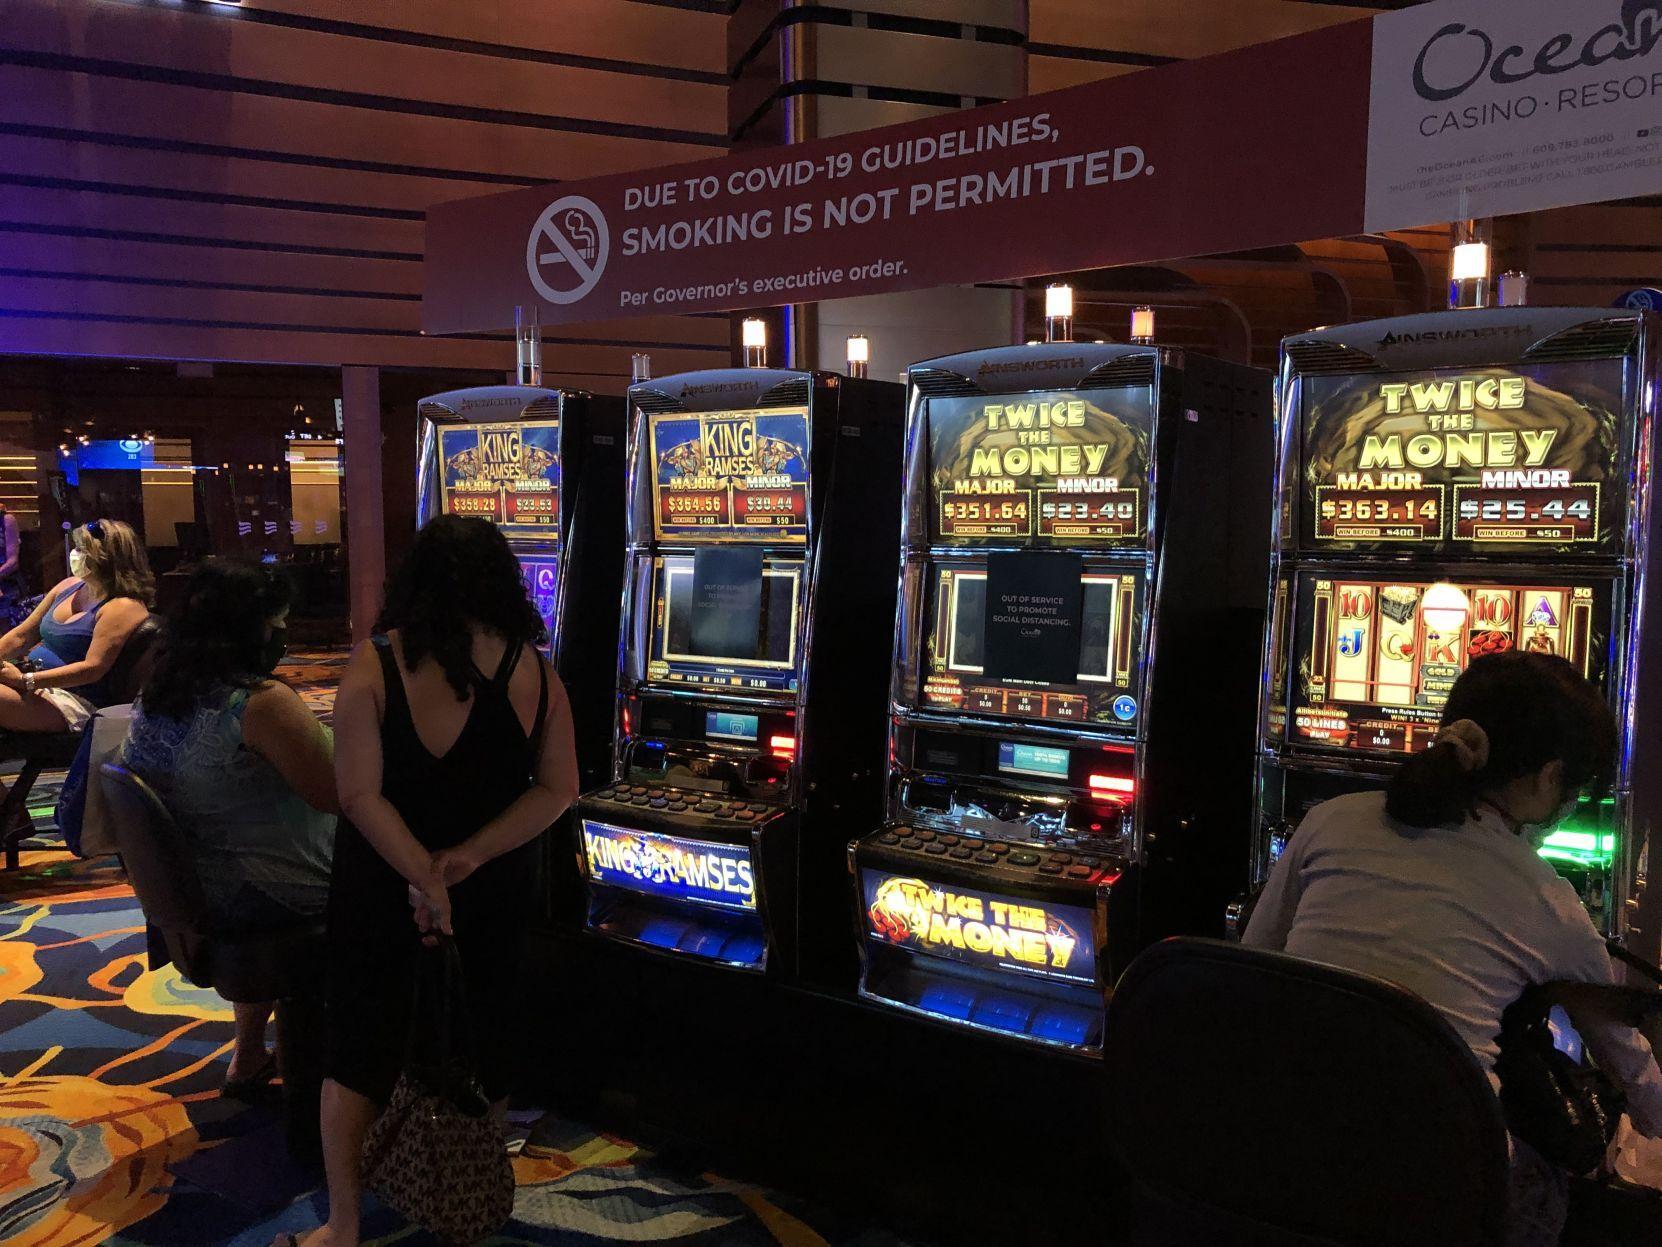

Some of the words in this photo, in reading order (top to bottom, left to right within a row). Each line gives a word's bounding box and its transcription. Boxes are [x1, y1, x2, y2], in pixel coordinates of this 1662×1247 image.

[1419, 96, 1538, 137] CASINO
[624, 182, 677, 211] DUE
[684, 175, 719, 202] TO
[727, 152, 853, 196] COVID-19
[861, 113, 1059, 173] GUIDELINES,
[622, 209, 773, 256] SMOKING
[783, 203, 813, 235] IS
[823, 188, 900, 229] NOT
[909, 145, 1155, 215] PERMITTED.
[620, 291, 648, 306] Per
[753, 266, 844, 291] executive
[849, 259, 908, 282] order.
[1379, 324, 1533, 346] AINSWORTH
[978, 357, 1085, 376] AINSWORTH
[1379, 376, 1526, 414] TWICE
[983, 400, 1086, 431] TWICE
[1428, 413, 1474, 431] THE
[704, 422, 753, 457] KING
[1019, 430, 1050, 445] THE
[481, 432, 520, 463] KING
[1358, 429, 1558, 470] MONEY
[705, 456, 754, 476] RAMSES
[969, 444, 1108, 477] MONEY
[482, 462, 521, 480] RAMSES
[1337, 473, 1424, 491] MAJOR
[1480, 470, 1571, 489] MINOR
[454, 479, 492, 492] MAJOR
[515, 480, 551, 492] MINOR
[670, 476, 716, 491] MAJOR
[746, 475, 792, 490] MINOR
[954, 478, 1016, 495] MAJOR
[1056, 477, 1119, 494] MINOR
[668, 496, 720, 513] $364.56
[944, 502, 1027, 520] $351.64
[1042, 502, 1133, 520] $23.40
[1322, 500, 1438, 521] $363.14
[1460, 500, 1591, 521] $25.44
[1337, 528, 1354, 536] WIN
[1354, 528, 1380, 537] BEFORE
[1387, 528, 1414, 537] $400
[1478, 529, 1495, 537] WIN
[1496, 529, 1525, 538] BEFORE
[1537, 529, 1561, 538] $50
[538, 568, 555, 590] Q
[1316, 580, 1331, 590] 50
[1001, 595, 1017, 603] OUT
[1031, 596, 1064, 605] SERVICE
[1574, 588, 1592, 598] 50
[1019, 606, 1057, 615] PROMOTE
[1339, 590, 1372, 620] 10
[1474, 593, 1513, 626] 10
[1523, 596, 1558, 628] A
[993, 615, 1020, 623] SOCIAL
[1022, 617, 1071, 626] DISTANCING.
[975, 686, 998, 694] CREDIT
[1312, 693, 1322, 701] 50
[1296, 717, 1310, 727] 50
[1312, 718, 1346, 730] LINES
[1366, 721, 1398, 730] CREDIT
[1379, 729, 1384, 737] 0
[1372, 737, 1390, 746] $0.00
[587, 832, 635, 874] KING
[661, 848, 755, 896] RAMSES
[899, 882, 984, 921] TWICE
[990, 902, 1046, 931] THE
[929, 912, 1076, 969] MONEY
